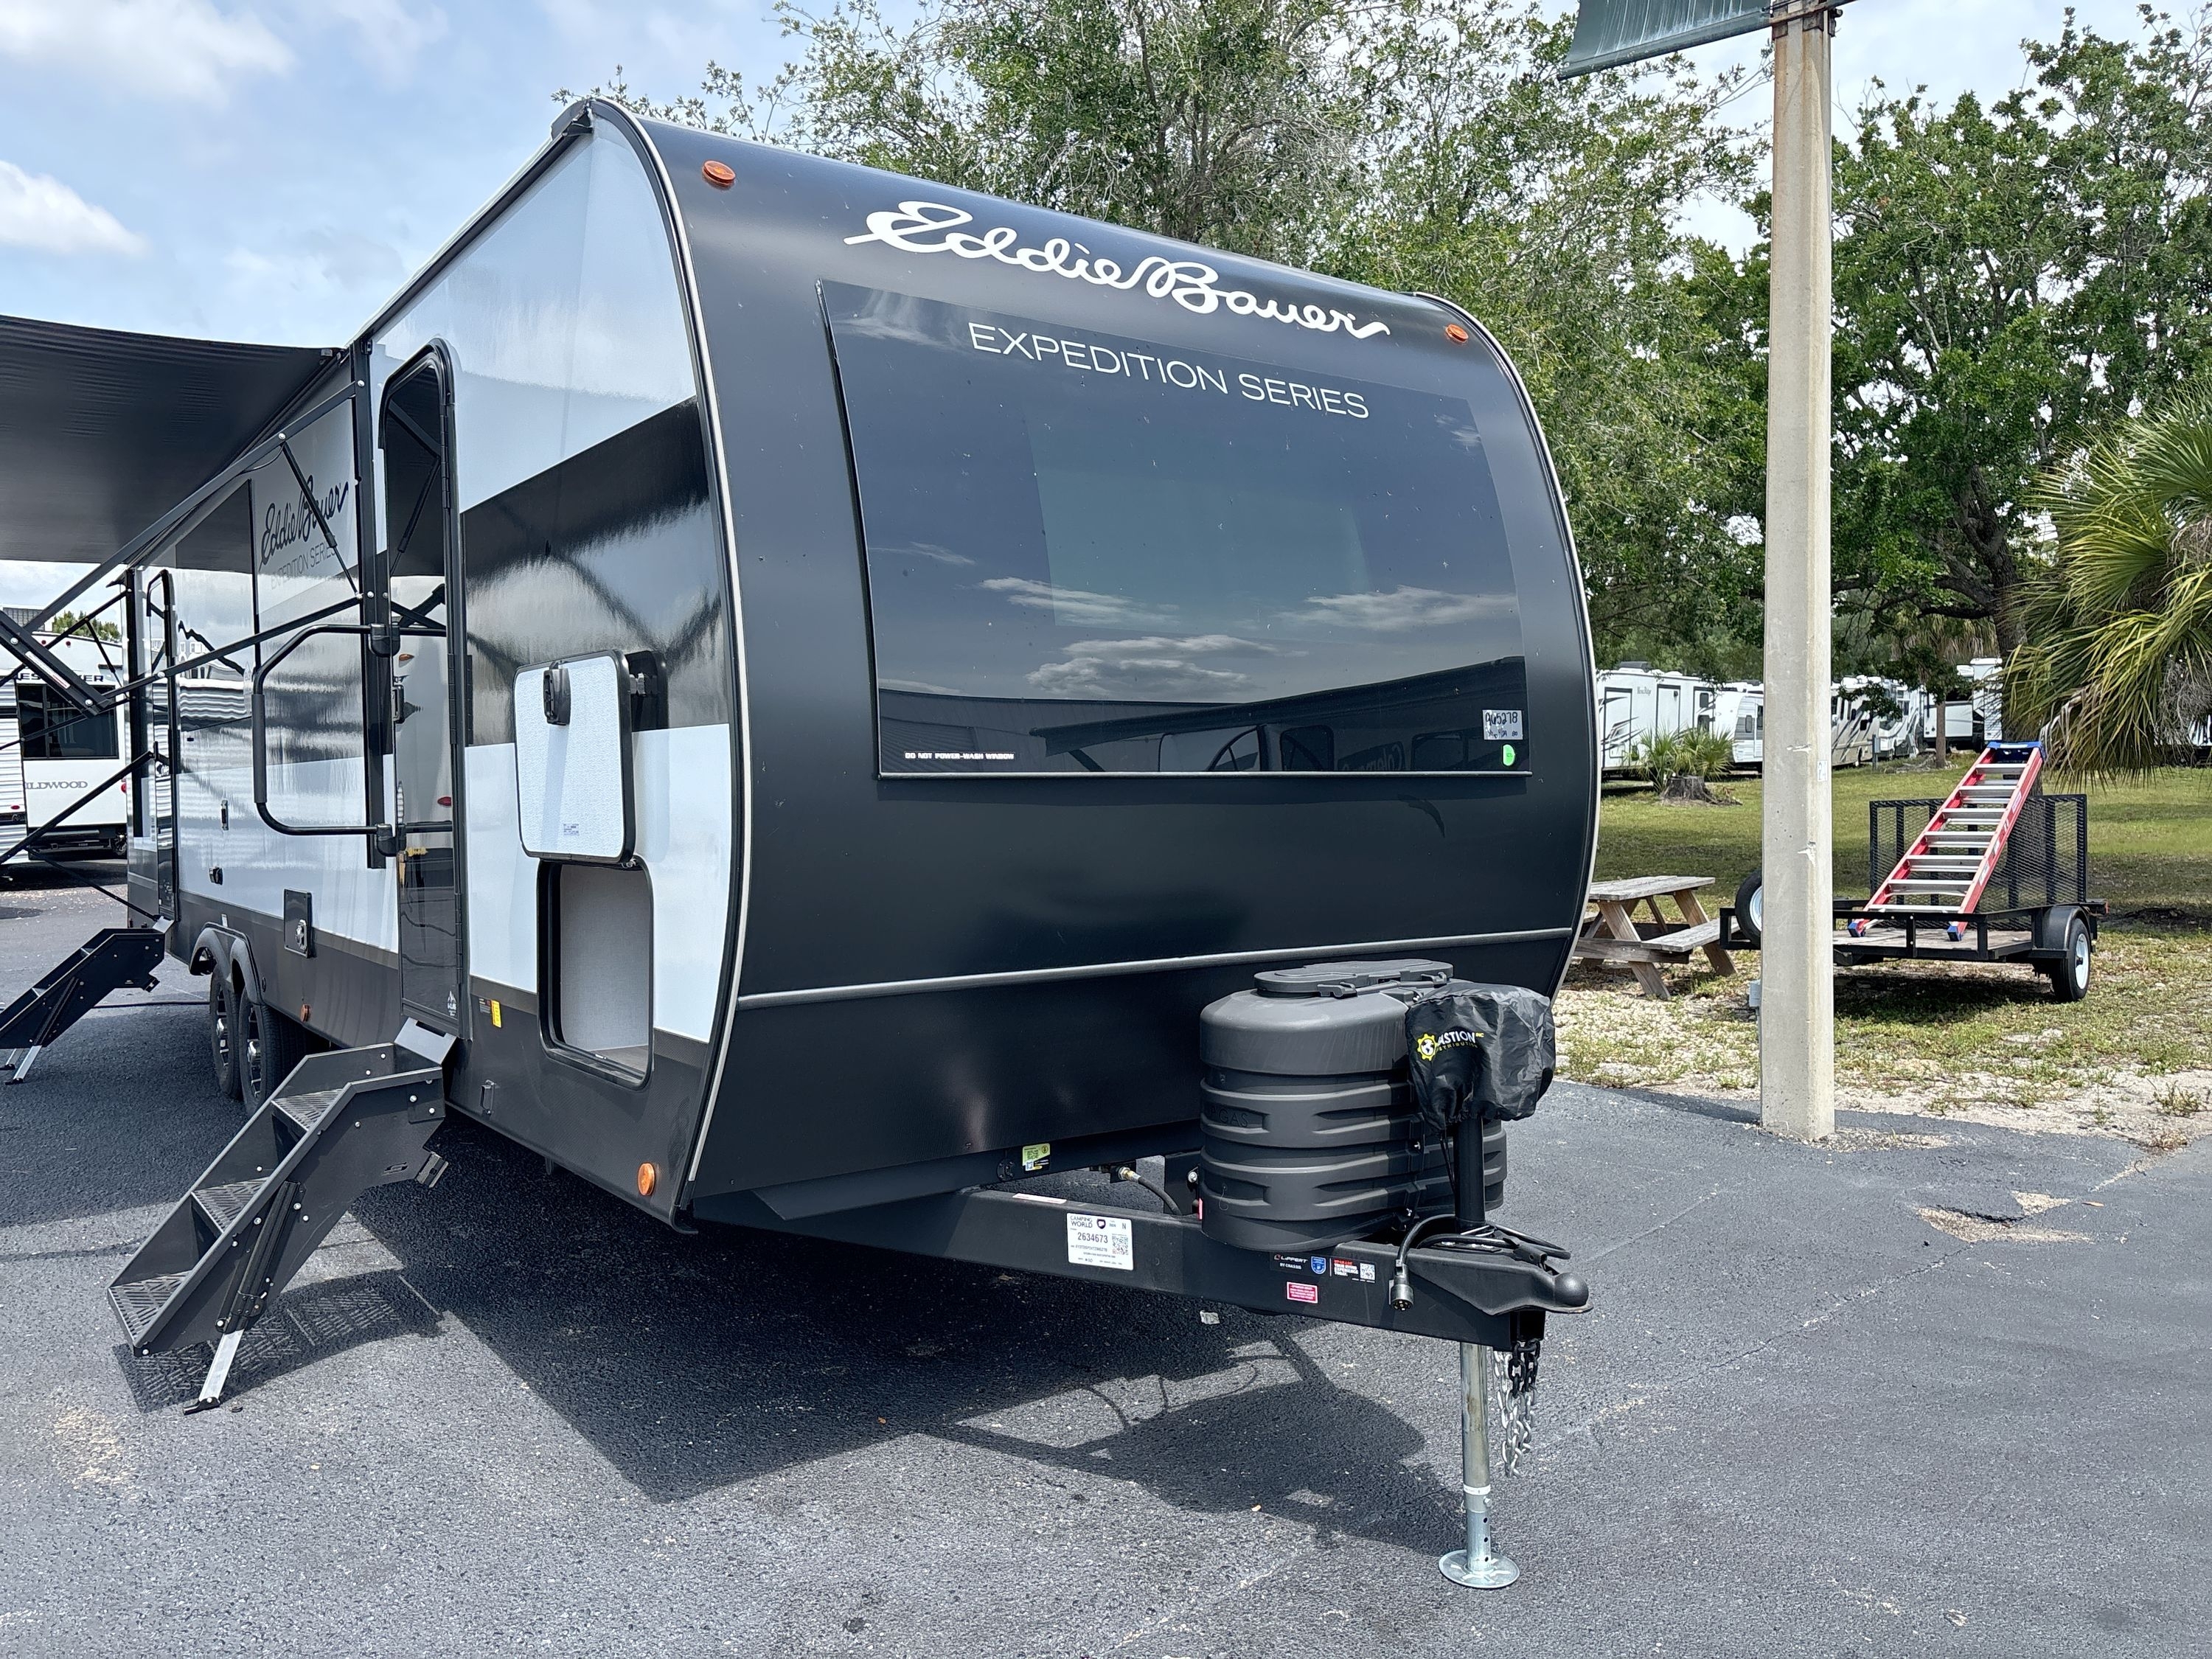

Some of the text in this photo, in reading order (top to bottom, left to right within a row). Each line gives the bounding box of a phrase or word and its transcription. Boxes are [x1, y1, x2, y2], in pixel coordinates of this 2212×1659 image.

[843, 201, 1391, 340] Eddie Bauer
[967, 321, 1370, 420] EXPEDITION SERIES
[259, 502, 296, 573] Eddie
[310, 541, 337, 568] SERIES
[1485, 712, 1518, 726] 965278
[25, 781, 88, 790] ILDWOOD
[1437, 1031, 1476, 1046] ASTION
[1219, 1107, 1248, 1127] GAS
[1071, 1220, 1093, 1228] WORLD
[1077, 1231, 1108, 1244] 2634673
